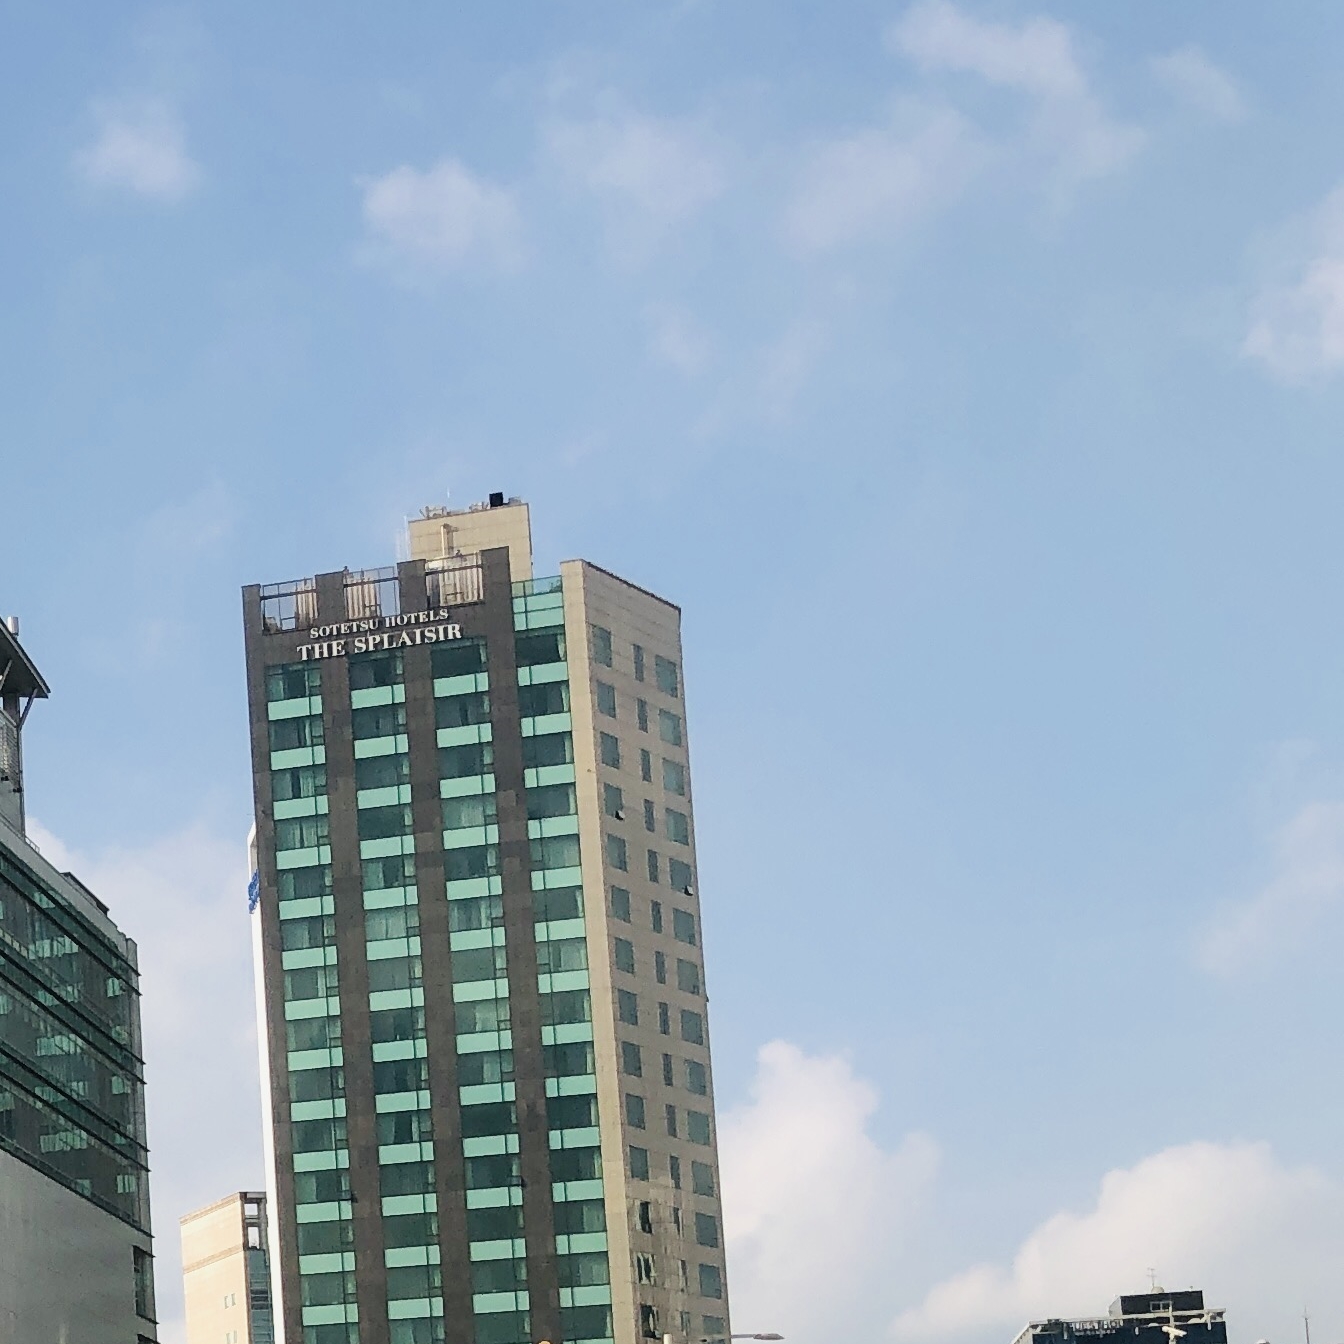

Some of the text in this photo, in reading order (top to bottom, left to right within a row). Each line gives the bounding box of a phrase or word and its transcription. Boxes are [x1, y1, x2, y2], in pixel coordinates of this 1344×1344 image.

[309, 608, 449, 639] SOTETSU HOTELS
[296, 623, 463, 661] THE SPLAISIR
